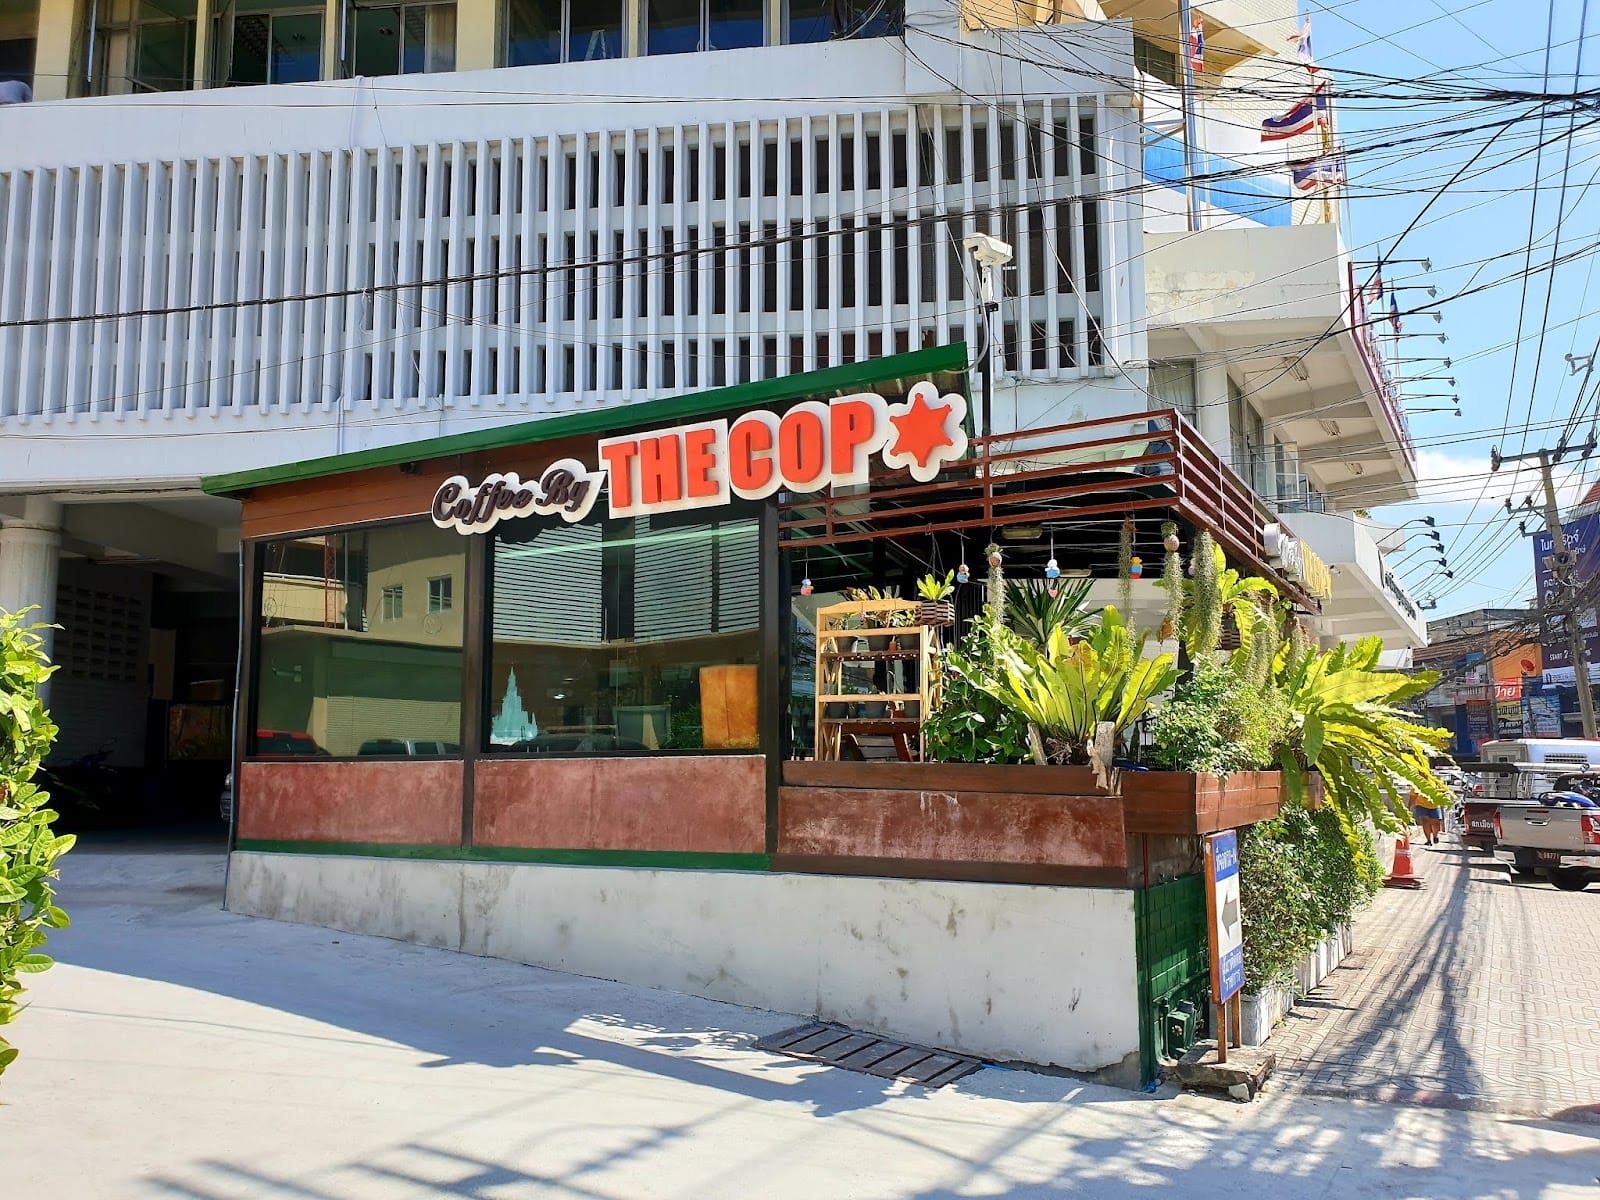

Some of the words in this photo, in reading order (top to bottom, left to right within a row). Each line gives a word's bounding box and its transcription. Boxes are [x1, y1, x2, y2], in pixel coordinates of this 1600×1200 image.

[433, 474, 533, 525] Coffee
[537, 467, 592, 513] By
[601, 427, 721, 508] THE
[729, 398, 875, 492] COP
